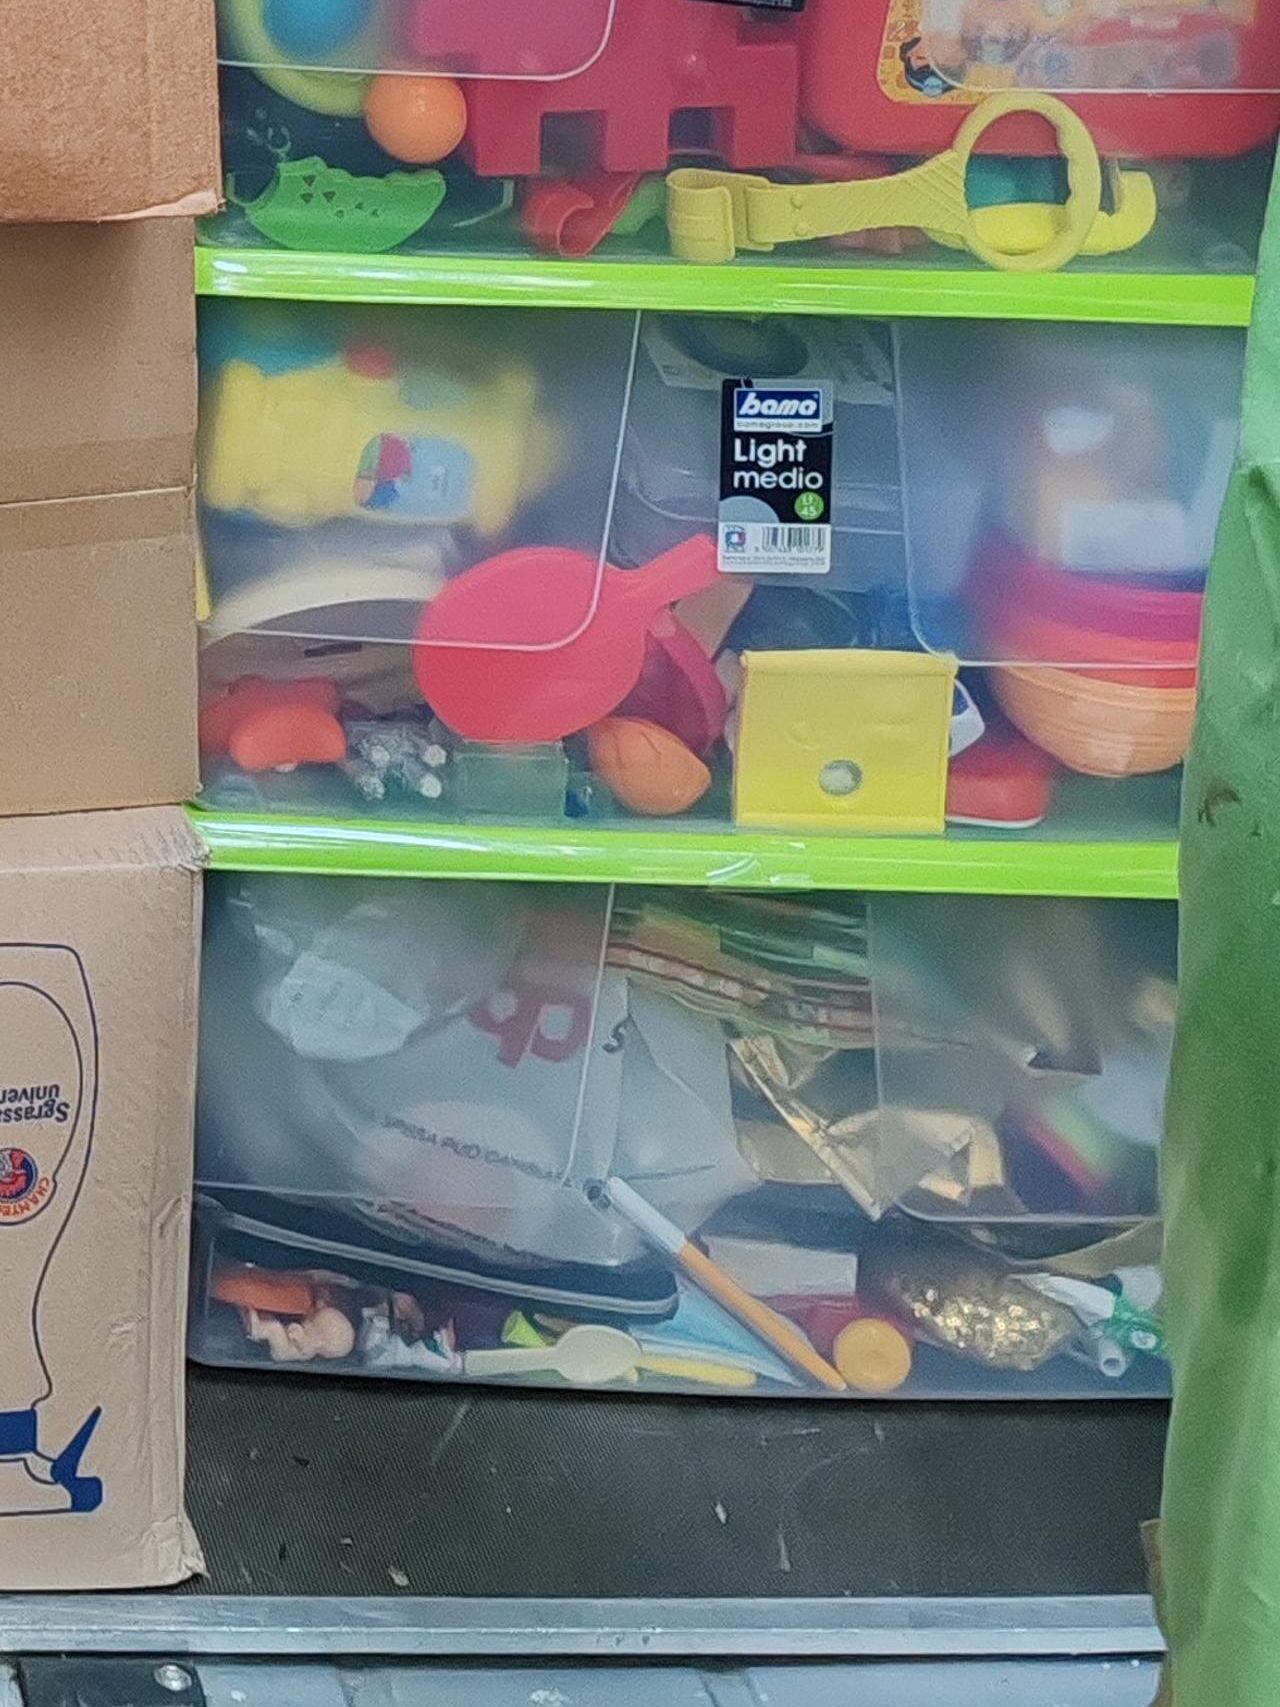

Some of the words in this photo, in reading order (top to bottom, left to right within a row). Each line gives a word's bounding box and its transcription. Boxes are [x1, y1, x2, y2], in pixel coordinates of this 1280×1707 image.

[739, 392, 818, 416] bama
[734, 439, 807, 468] Light
[733, 467, 823, 489] medio
